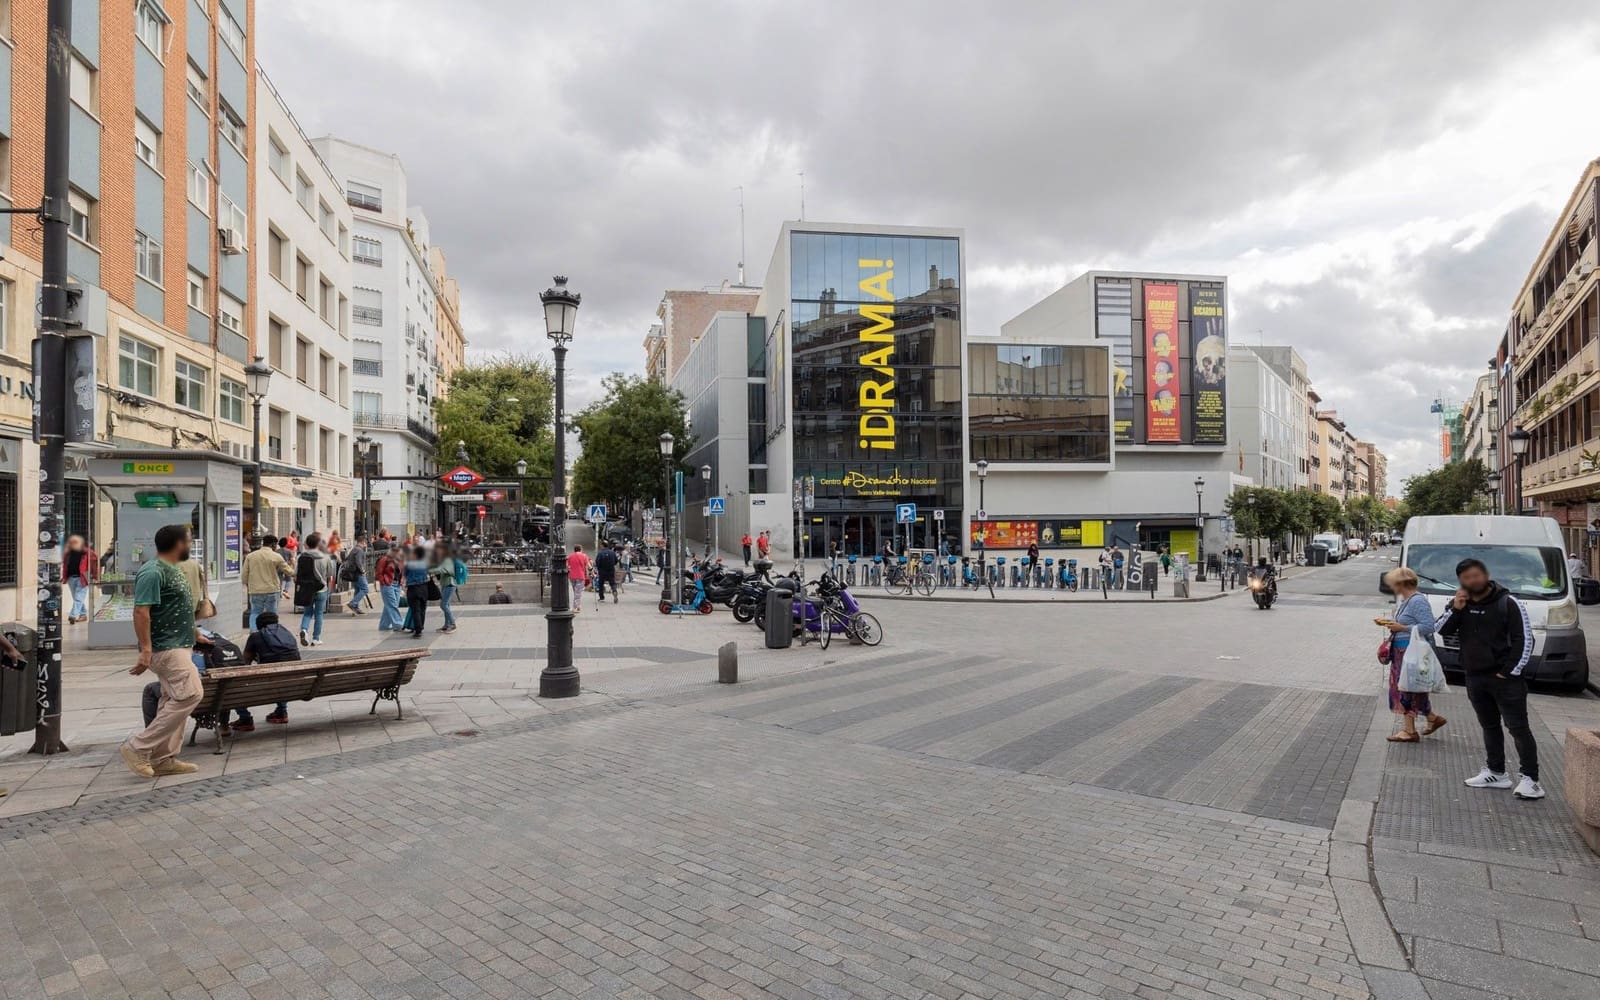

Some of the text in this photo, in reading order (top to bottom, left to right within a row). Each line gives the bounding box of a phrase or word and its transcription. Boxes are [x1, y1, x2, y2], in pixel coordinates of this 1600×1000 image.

[859, 258, 895, 450] ¡DRAMA!
[138, 464, 169, 473] ONCE
[900, 506, 912, 521] P
